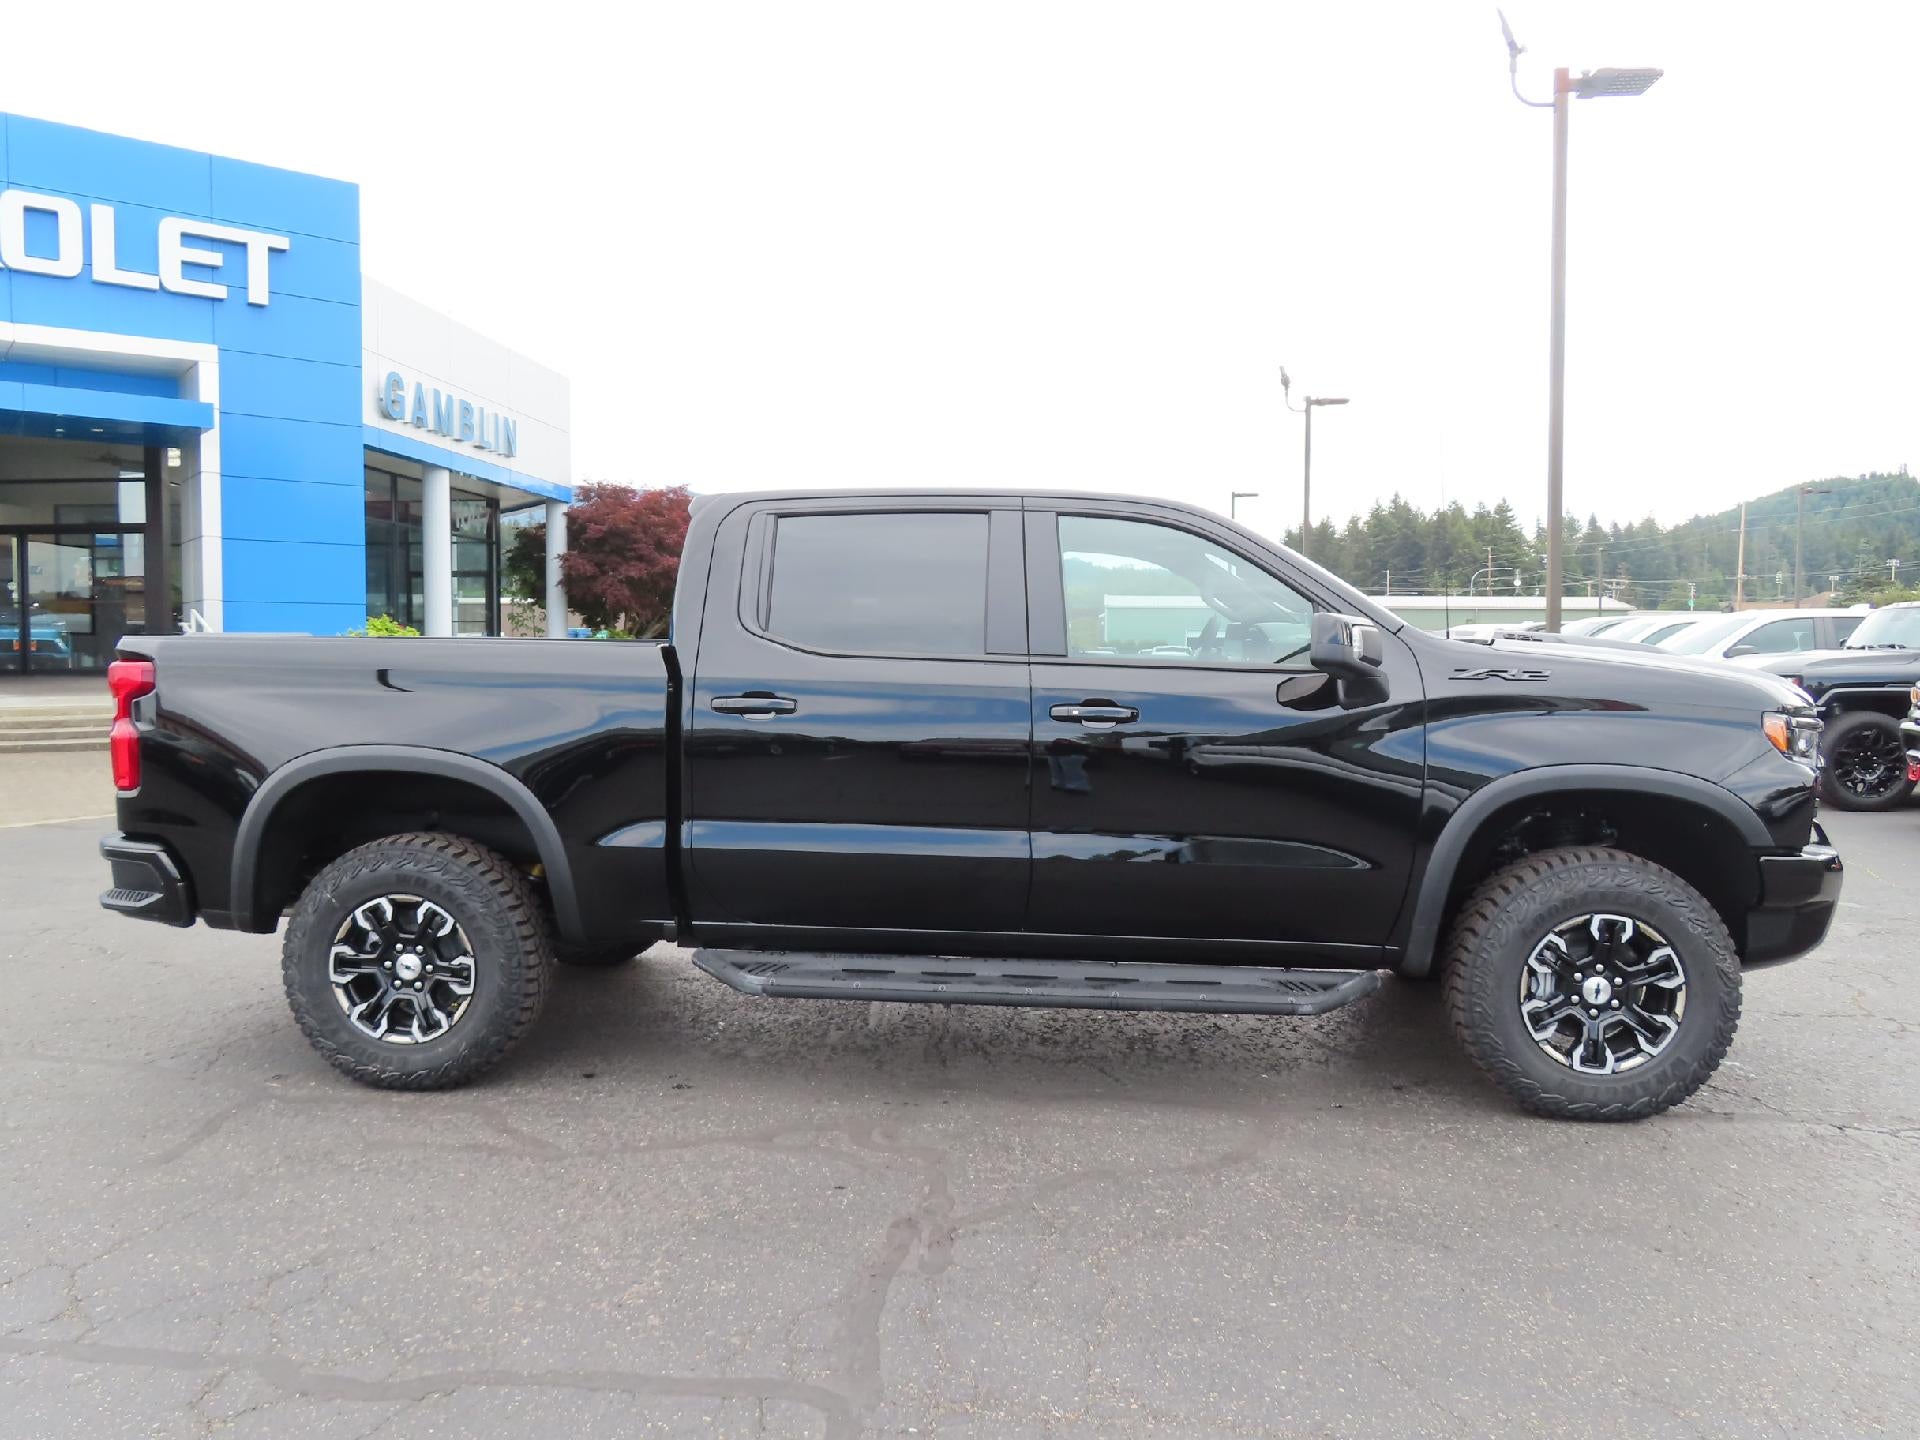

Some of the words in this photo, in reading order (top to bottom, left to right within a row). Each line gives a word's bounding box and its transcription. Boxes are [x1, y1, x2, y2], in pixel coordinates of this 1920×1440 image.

[0, 189, 289, 306] OLET
[381, 371, 517, 458] GAMBLIN
[1448, 668, 1552, 682] ZR2
